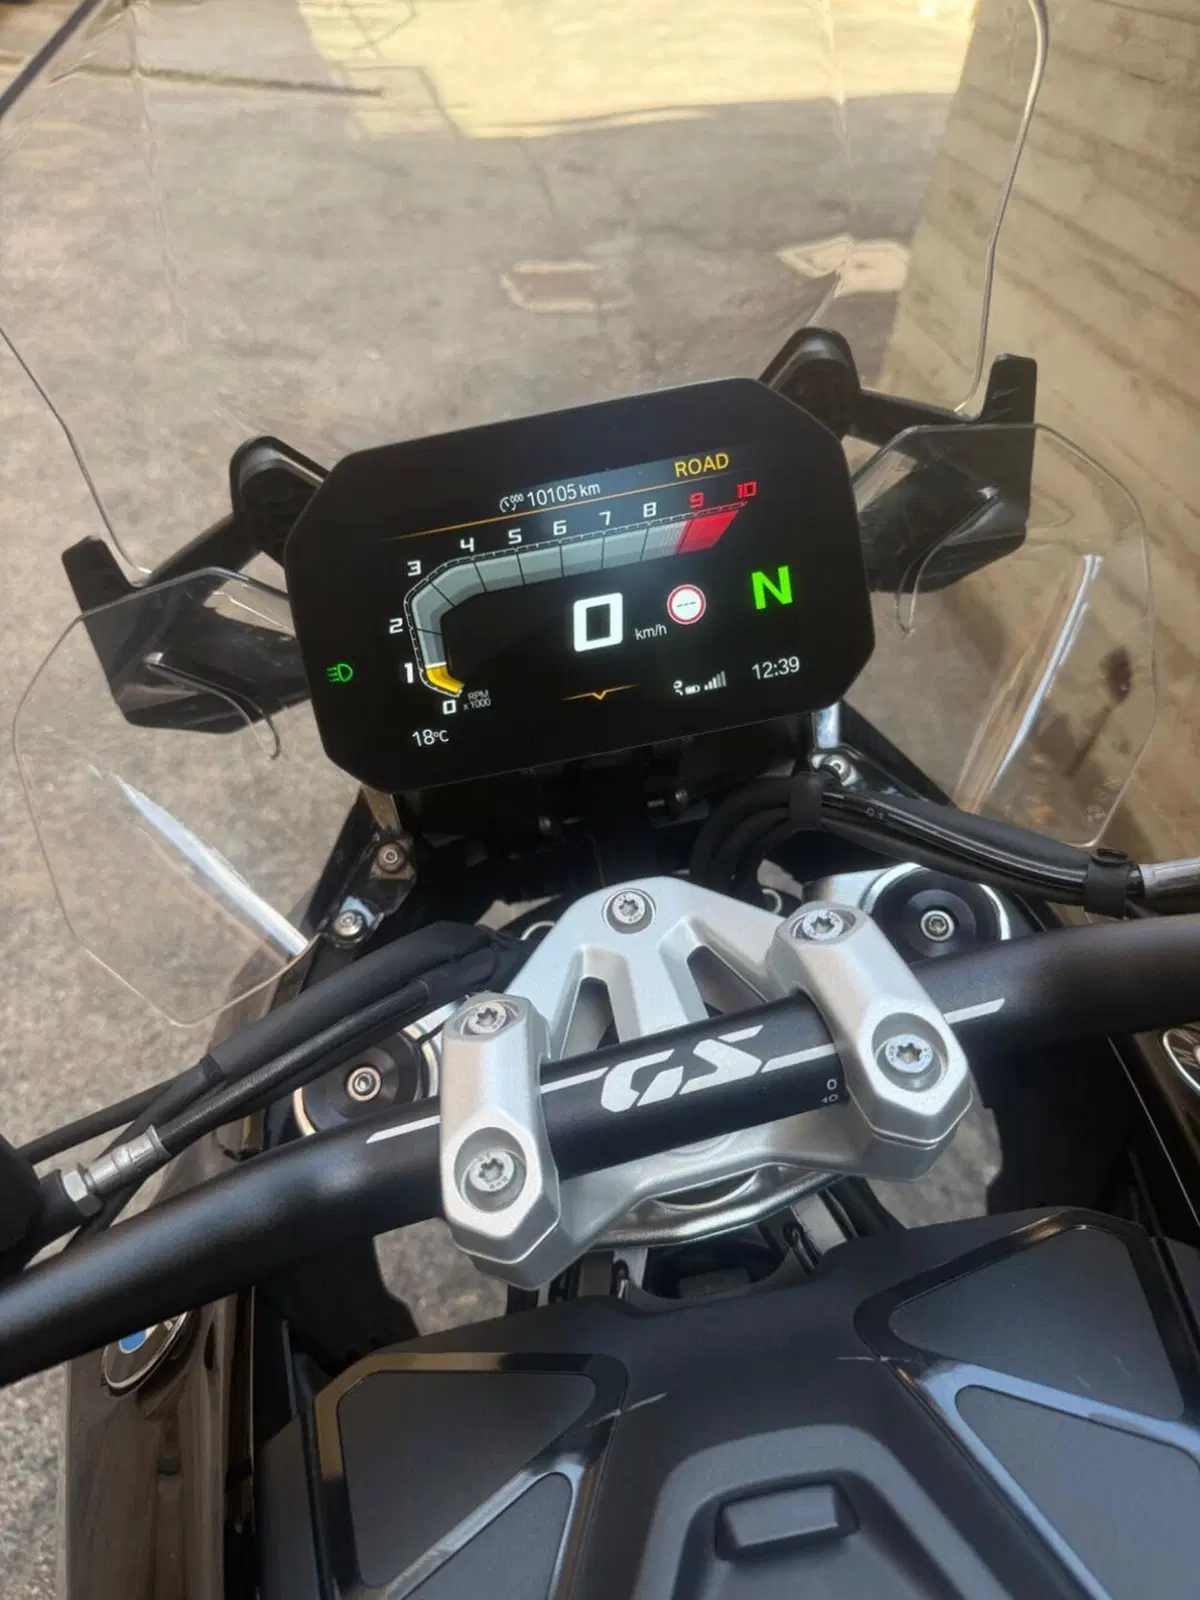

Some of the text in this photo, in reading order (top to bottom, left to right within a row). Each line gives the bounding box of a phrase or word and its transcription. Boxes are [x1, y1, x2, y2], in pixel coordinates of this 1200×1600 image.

[674, 452, 730, 478] ROAD
[526, 483, 578, 508] 10105
[580, 481, 601, 496] km
[460, 481, 758, 552] 4 5 6 7 8 9 10
[407, 559, 422, 577] 3
[751, 565, 793, 610] N
[389, 617, 404, 635] 2
[573, 592, 668, 652] 0 km/h
[403, 662, 414, 684] 1
[752, 655, 801, 681] 12:39
[442, 699, 457, 715] 0
[467, 689, 490, 701] RPM
[469, 698, 492, 709] 1000
[600, 1024, 764, 1113] GS
